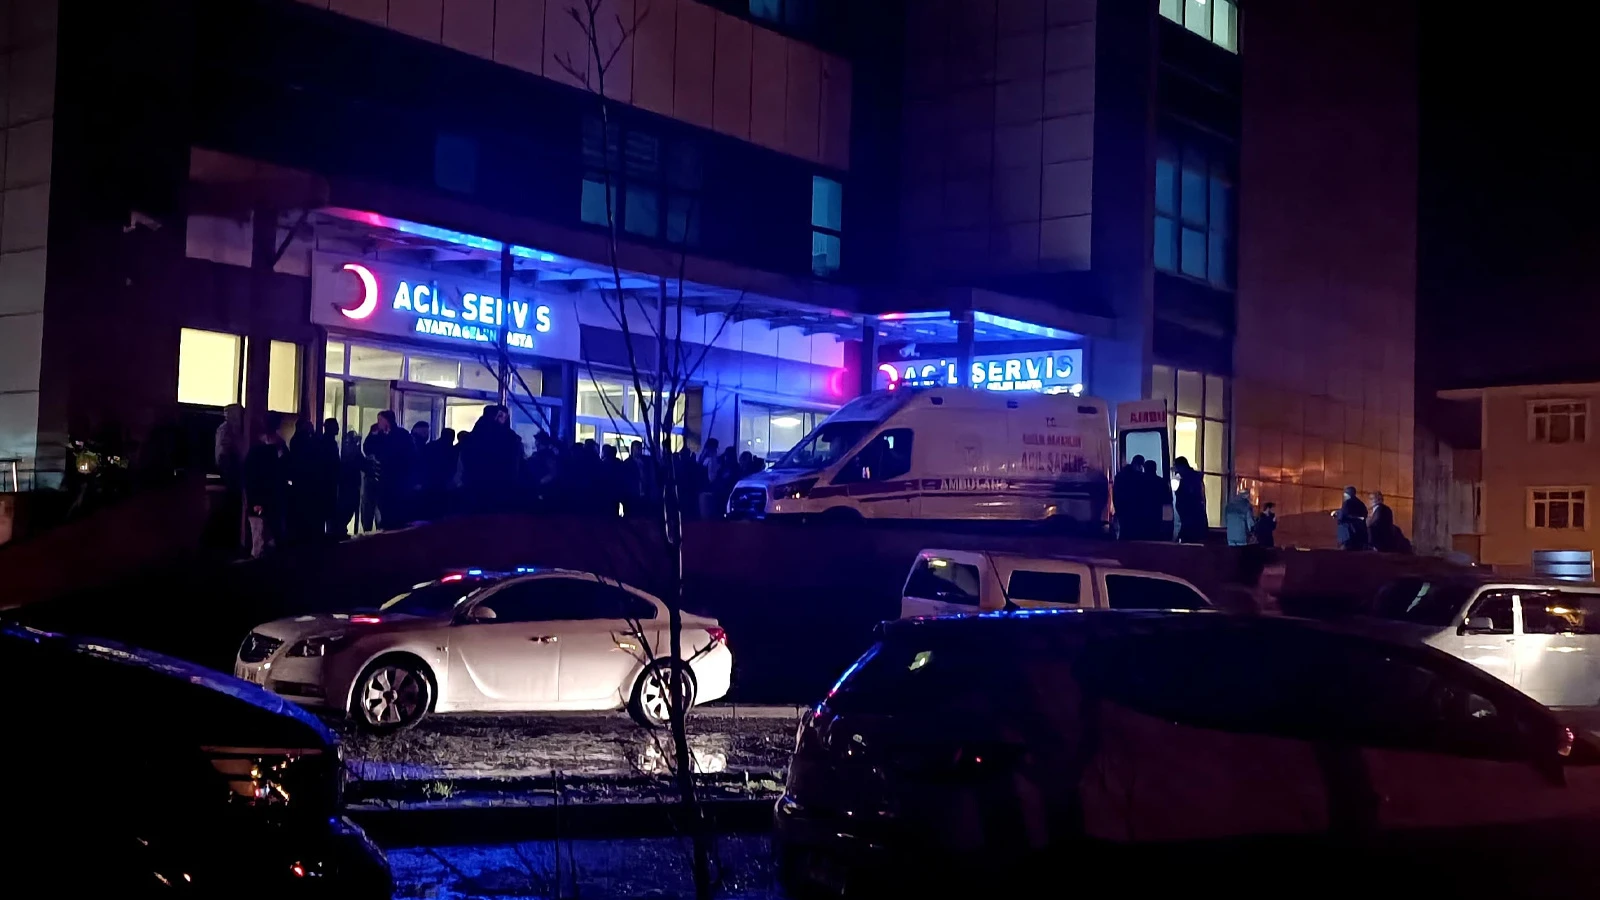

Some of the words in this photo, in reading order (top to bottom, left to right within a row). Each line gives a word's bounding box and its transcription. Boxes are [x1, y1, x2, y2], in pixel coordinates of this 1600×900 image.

[461, 293, 551, 333] SEVS
[507, 331, 534, 348] ASTA
[904, 360, 958, 384] ACL
